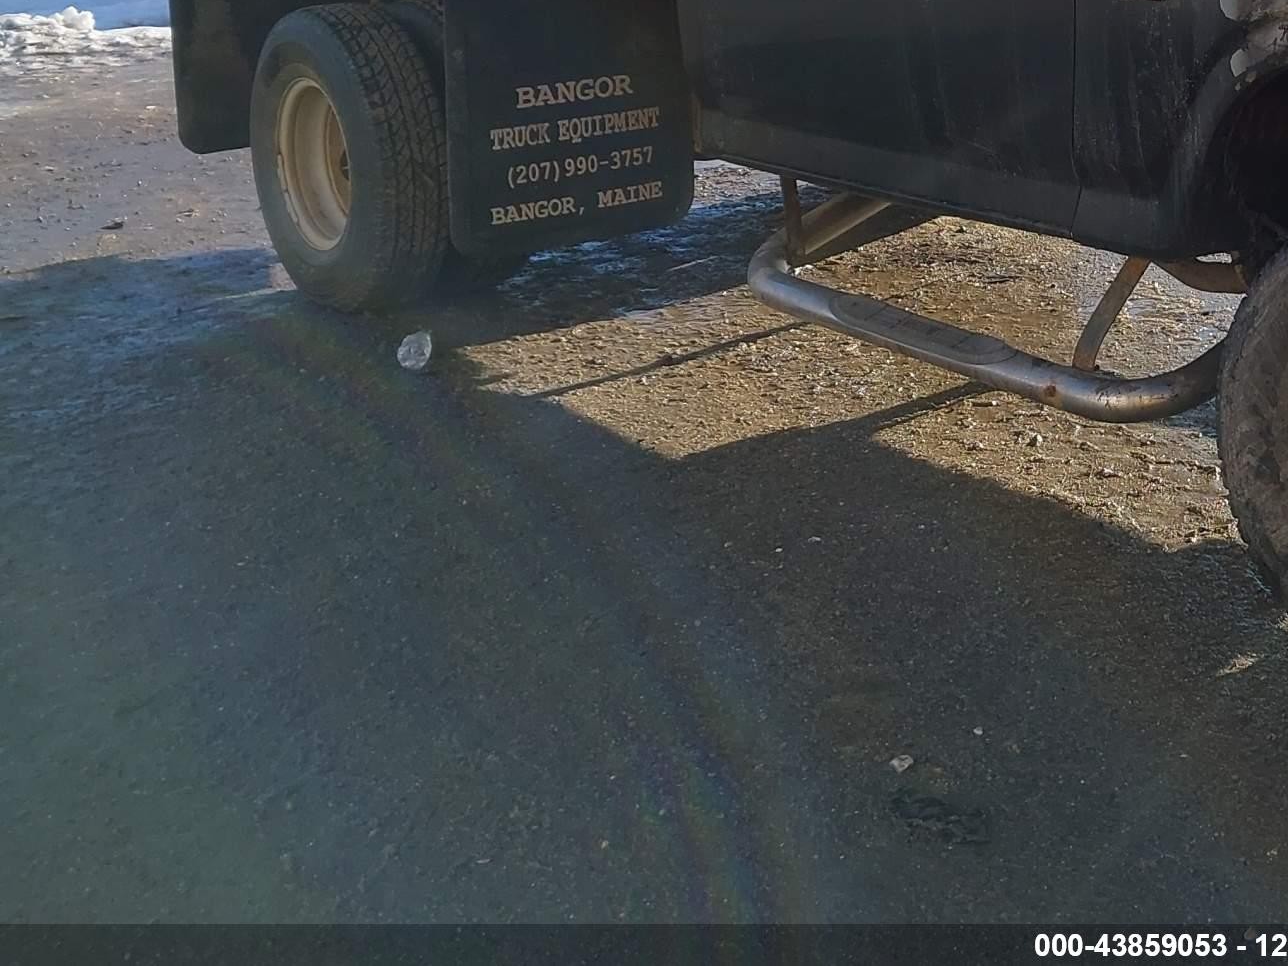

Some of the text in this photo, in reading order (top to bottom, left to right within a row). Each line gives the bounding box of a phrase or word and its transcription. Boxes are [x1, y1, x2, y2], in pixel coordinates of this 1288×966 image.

[516, 75, 633, 109] BANGOR
[490, 107, 659, 150] TRUCK EQUIPMENT
[490, 181, 662, 225] BANGOR, MAINE
